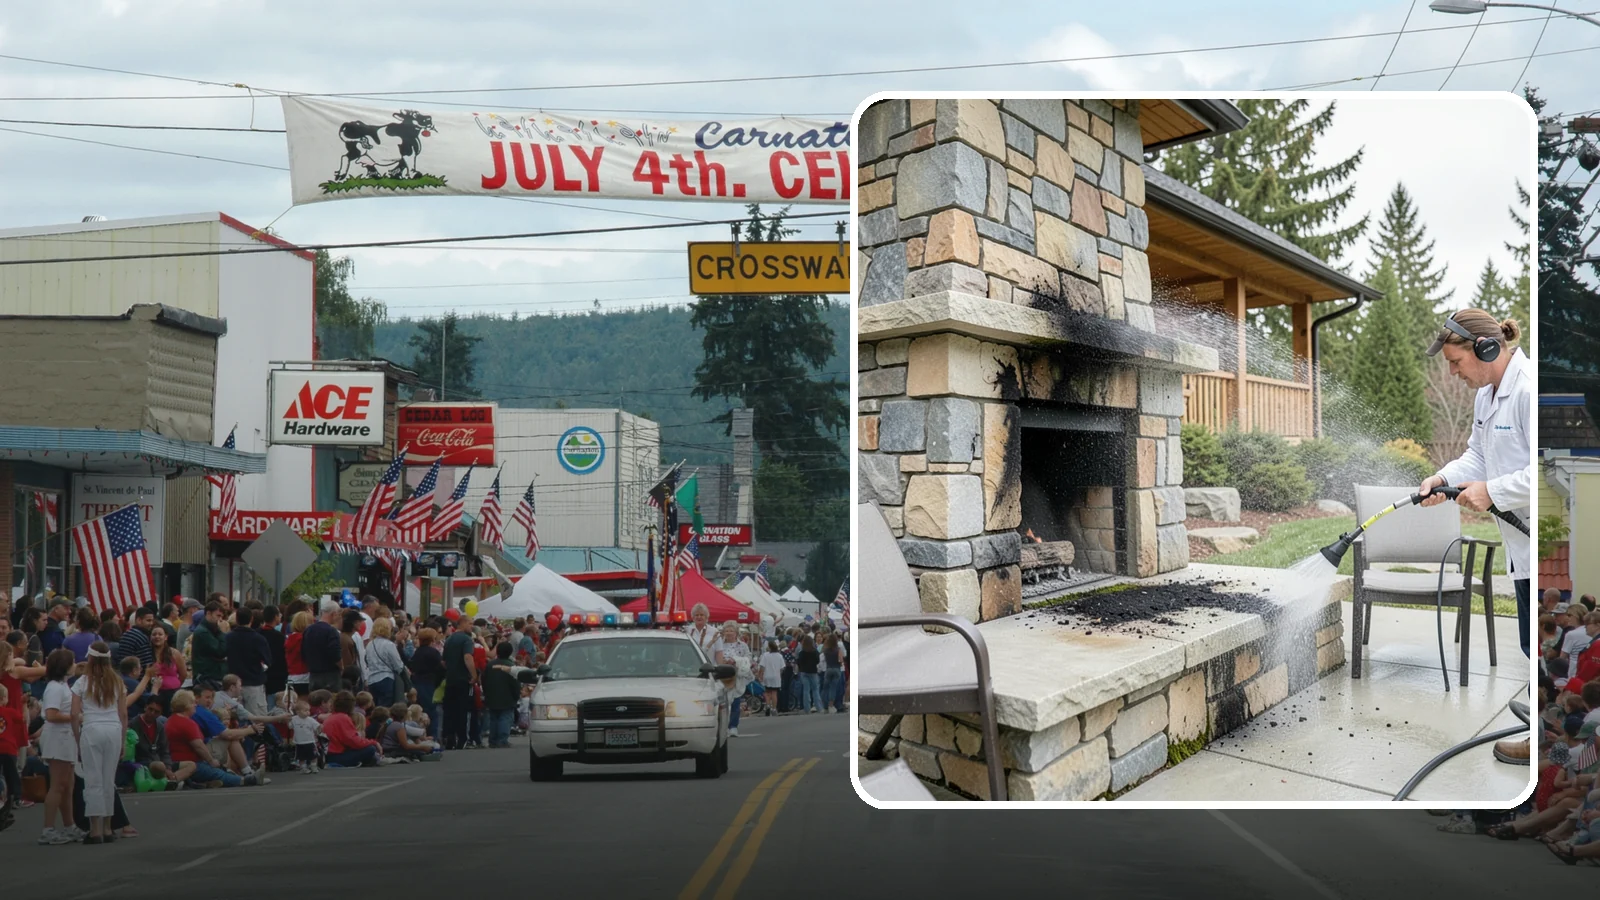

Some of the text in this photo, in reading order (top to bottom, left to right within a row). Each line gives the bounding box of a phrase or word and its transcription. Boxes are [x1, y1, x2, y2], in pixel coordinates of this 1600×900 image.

[481, 141, 605, 192] JULY
[632, 150, 747, 198] 4th.
[697, 254, 850, 281] CROSSWA
[282, 380, 374, 420] ACE
[405, 409, 485, 423] CEDAR LOG
[283, 421, 371, 437] Hardware
[416, 428, 478, 447] Coca-Cola
[83, 485, 155, 495] St. Vincent de Paul
[688, 526, 741, 535] CRNATION
[699, 535, 730, 543] GLASS
